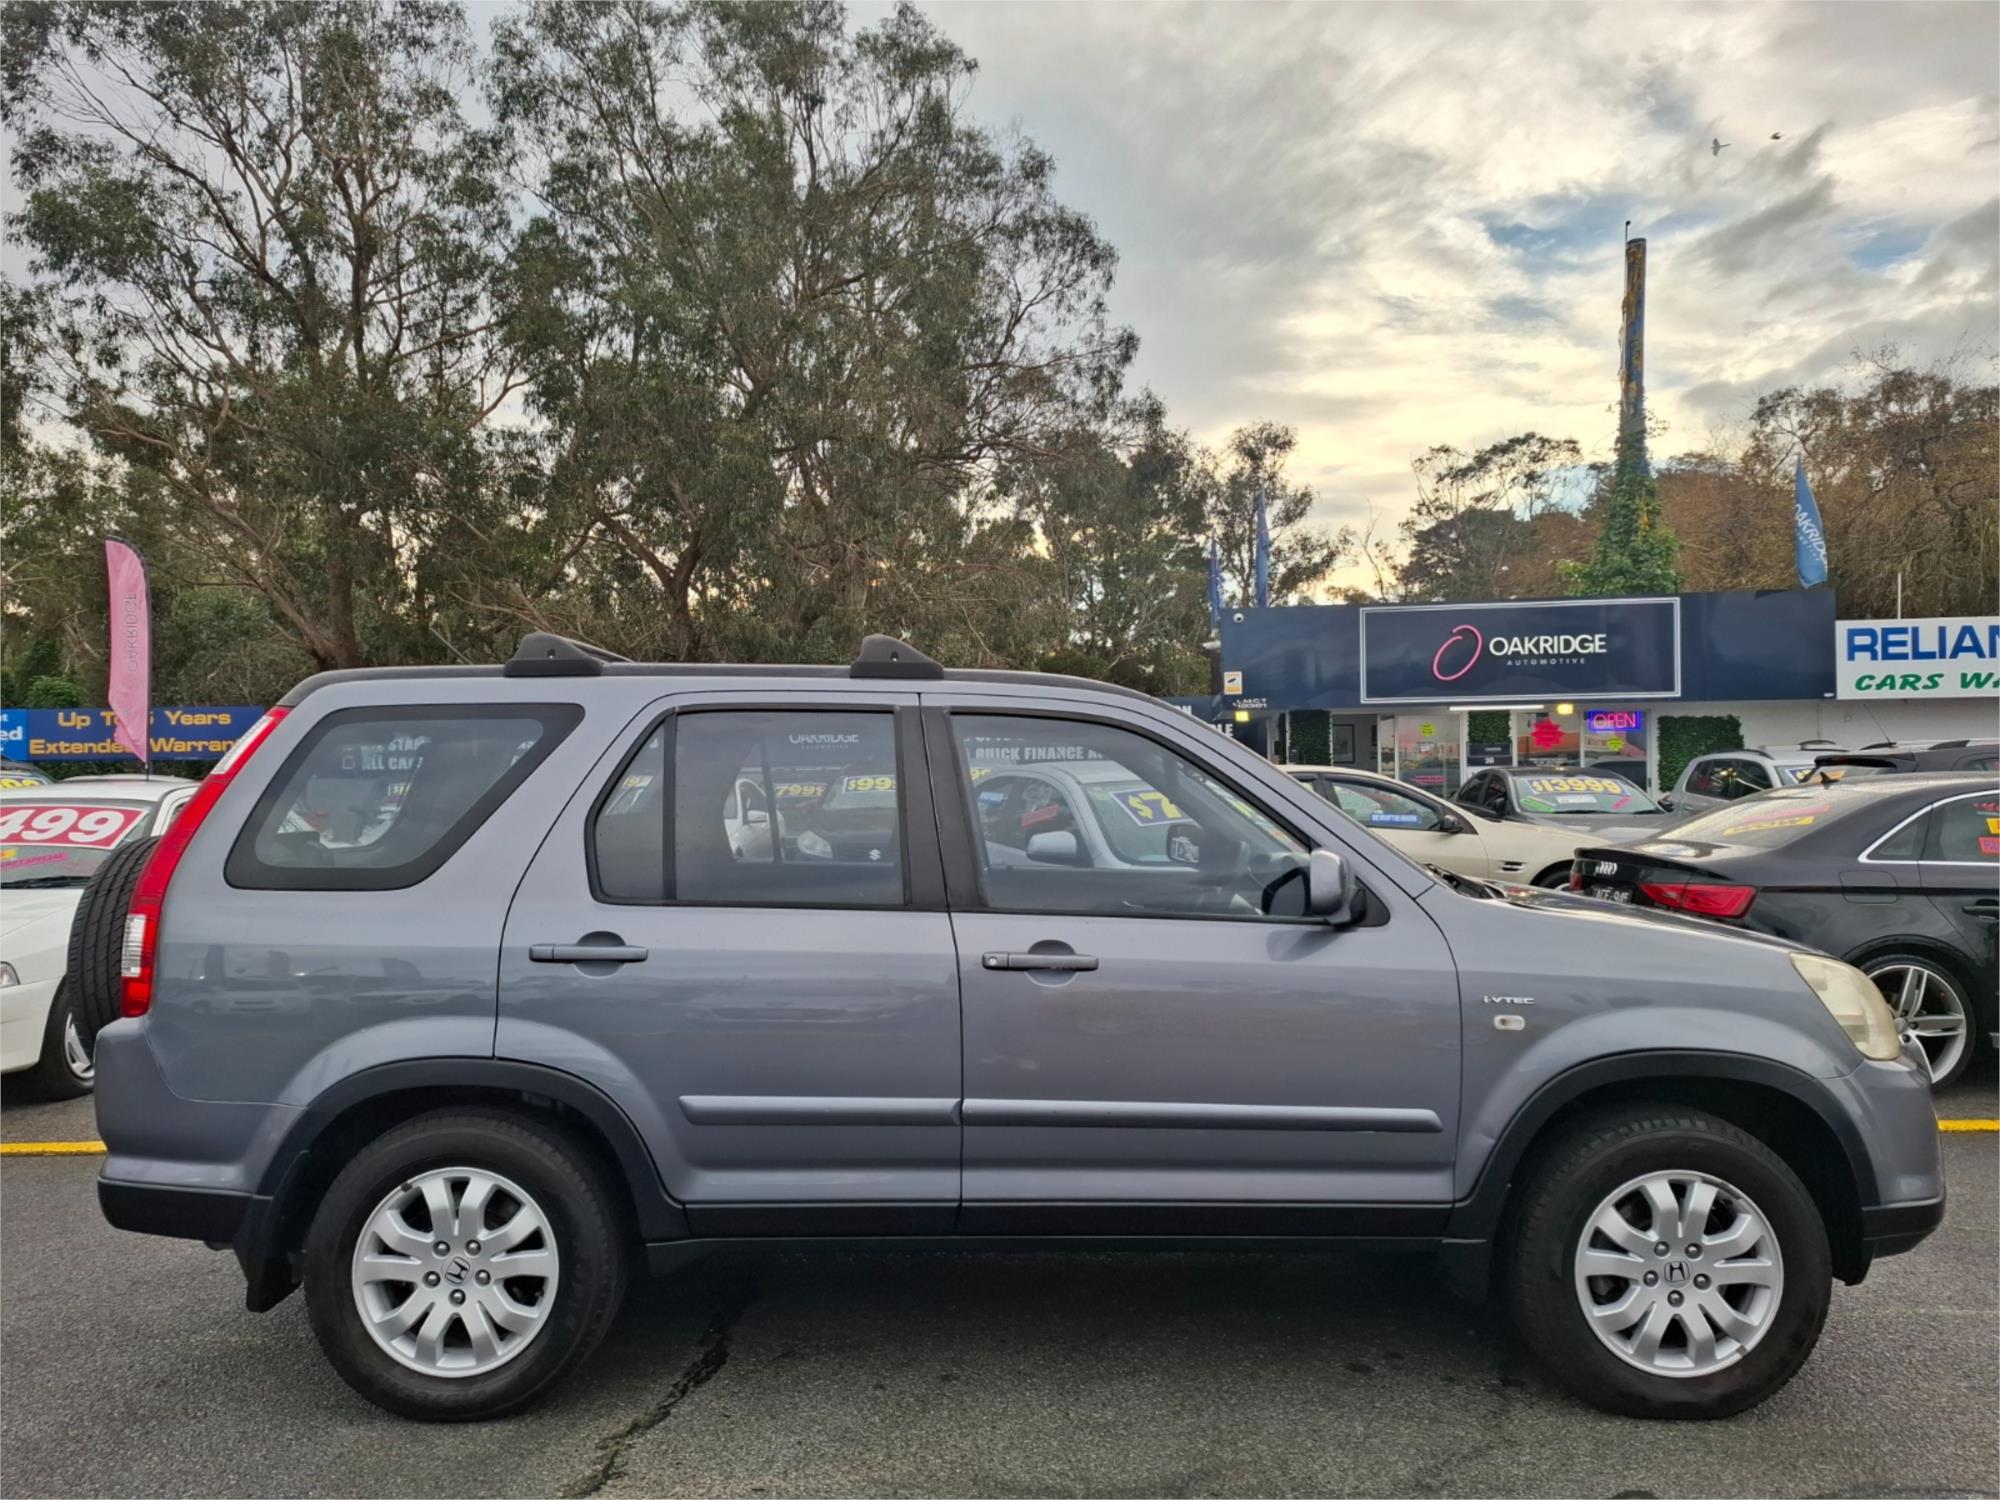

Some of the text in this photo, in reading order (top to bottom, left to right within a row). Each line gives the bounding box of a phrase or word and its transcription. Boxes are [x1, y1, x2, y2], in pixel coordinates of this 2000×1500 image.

[1489, 633, 1607, 656] OAKRIDGE
[1855, 673, 1944, 691] CARS
[58, 711, 91, 729] Up
[164, 710, 231, 725] Years
[1594, 712, 1636, 728] OPEN
[1024, 746, 1084, 760] FINANCE
